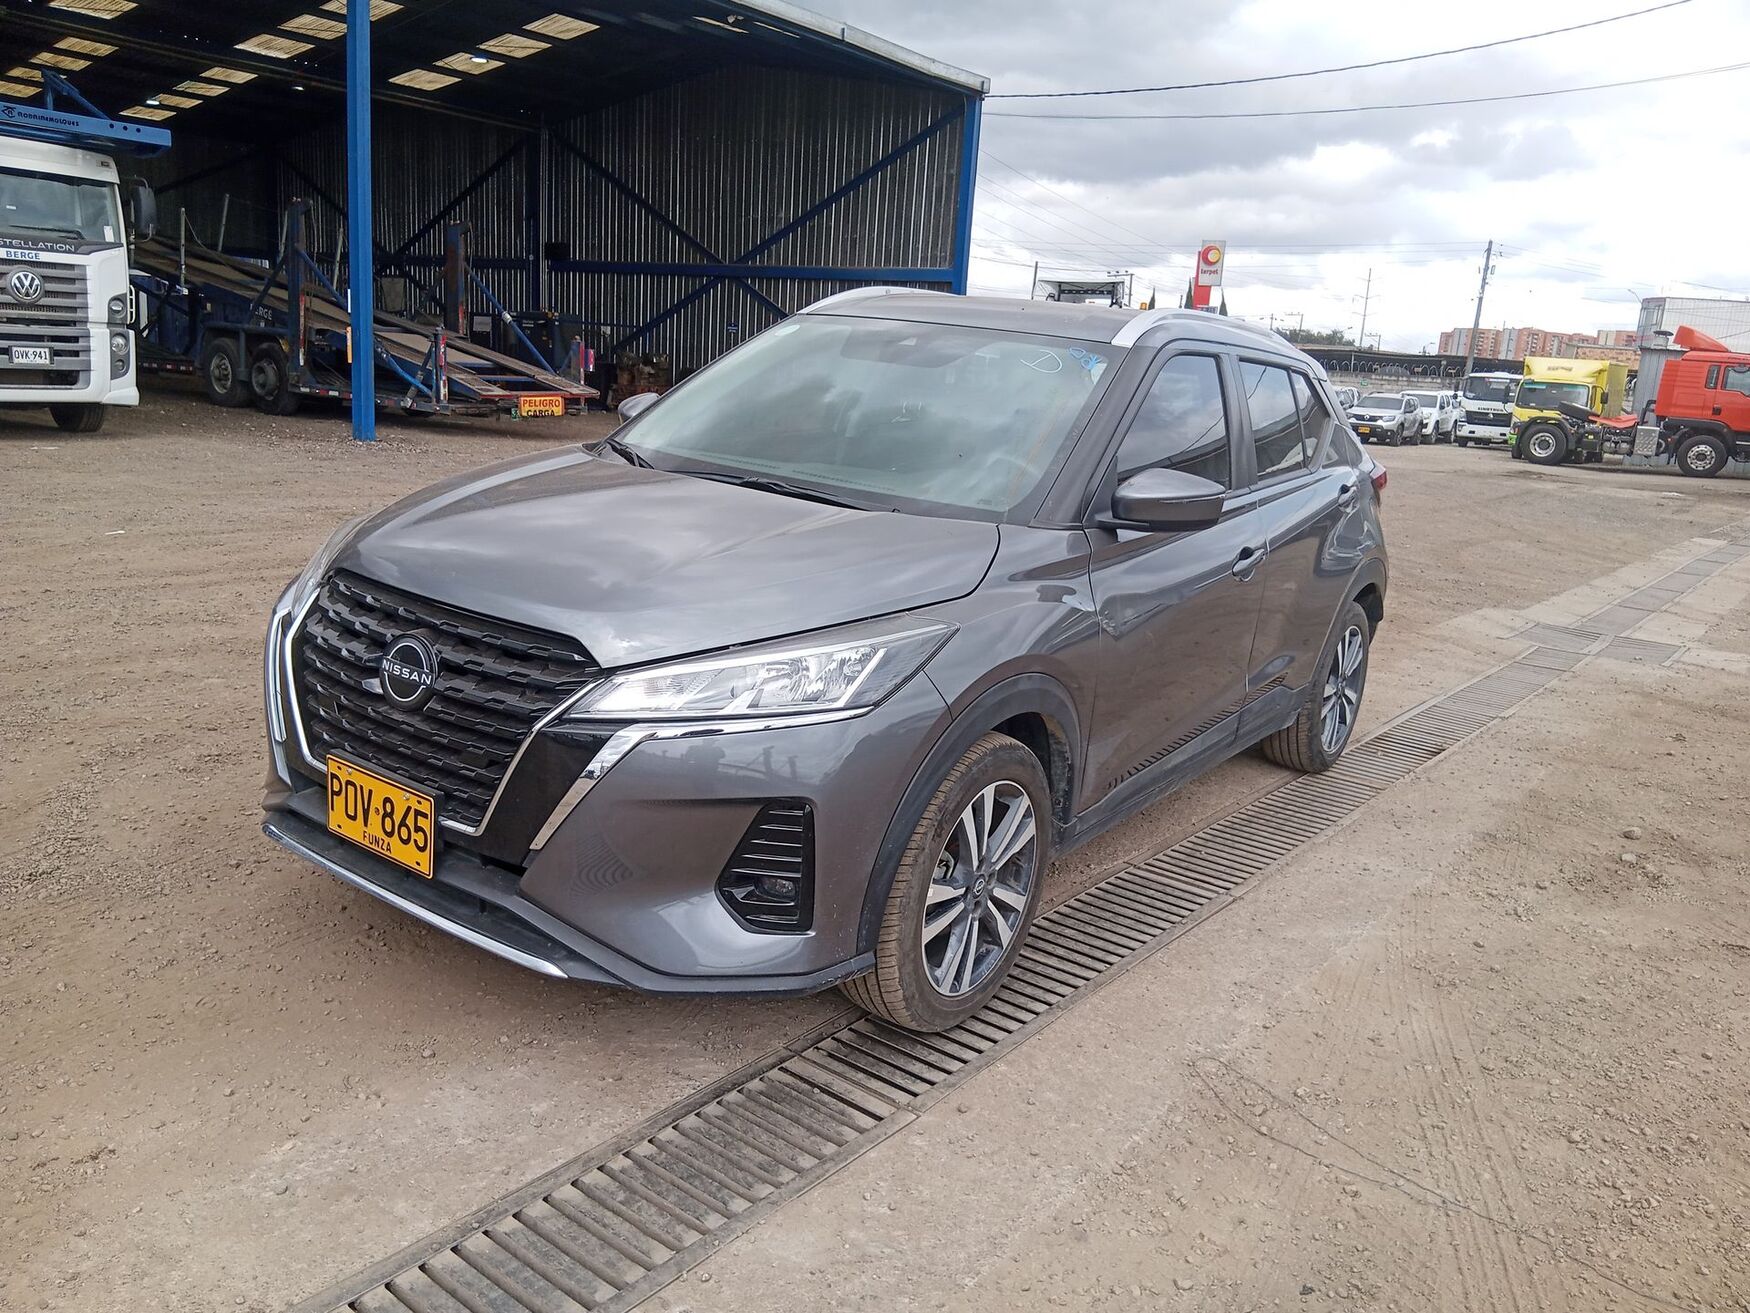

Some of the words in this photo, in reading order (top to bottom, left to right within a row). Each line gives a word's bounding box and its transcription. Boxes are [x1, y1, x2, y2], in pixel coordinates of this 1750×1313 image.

[6, 250, 41, 260] BERGE
[522, 399, 561, 408] PELIGRO
[526, 409, 555, 417] CARGA
[382, 659, 432, 685] NISSAN
[362, 830, 392, 854] FUNZA
